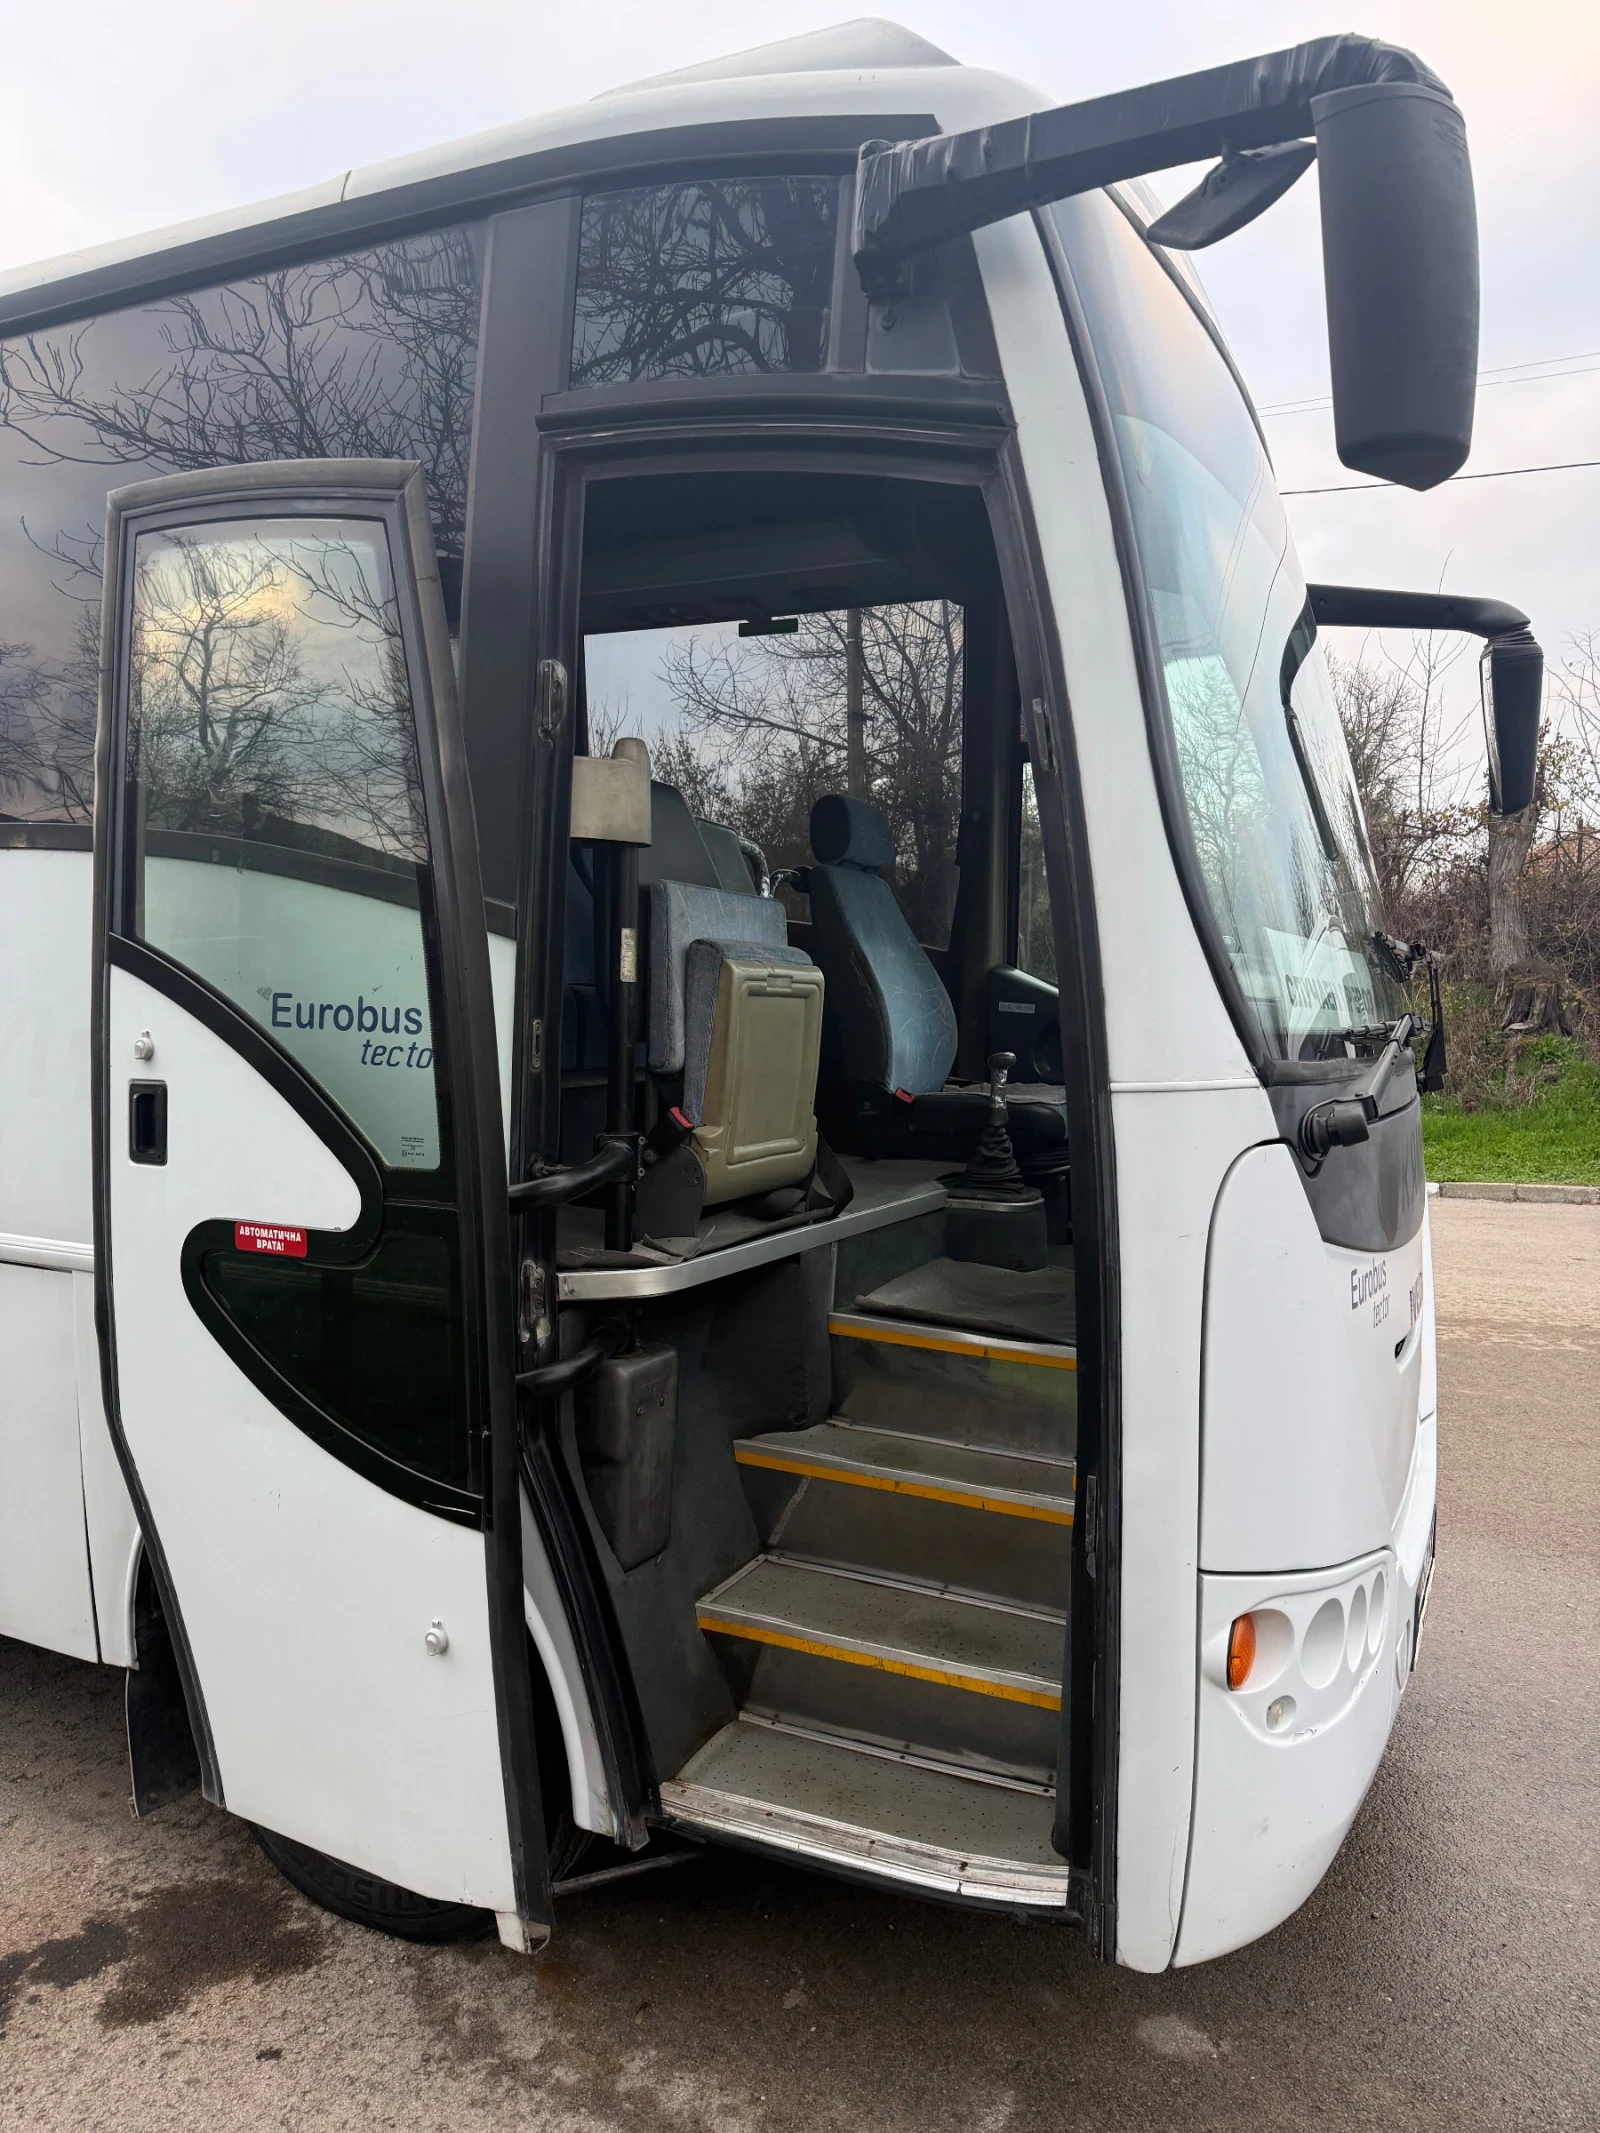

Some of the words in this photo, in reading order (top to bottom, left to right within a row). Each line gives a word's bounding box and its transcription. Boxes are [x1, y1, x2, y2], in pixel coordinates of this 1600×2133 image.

[272, 992, 423, 1035] Eurobus
[361, 1039, 433, 1069] tecto
[239, 1225, 302, 1242] АВТОМАТИЧНА
[256, 1239, 284, 1251] ВРАТА!
[1351, 1257, 1387, 1310] Eurobus
